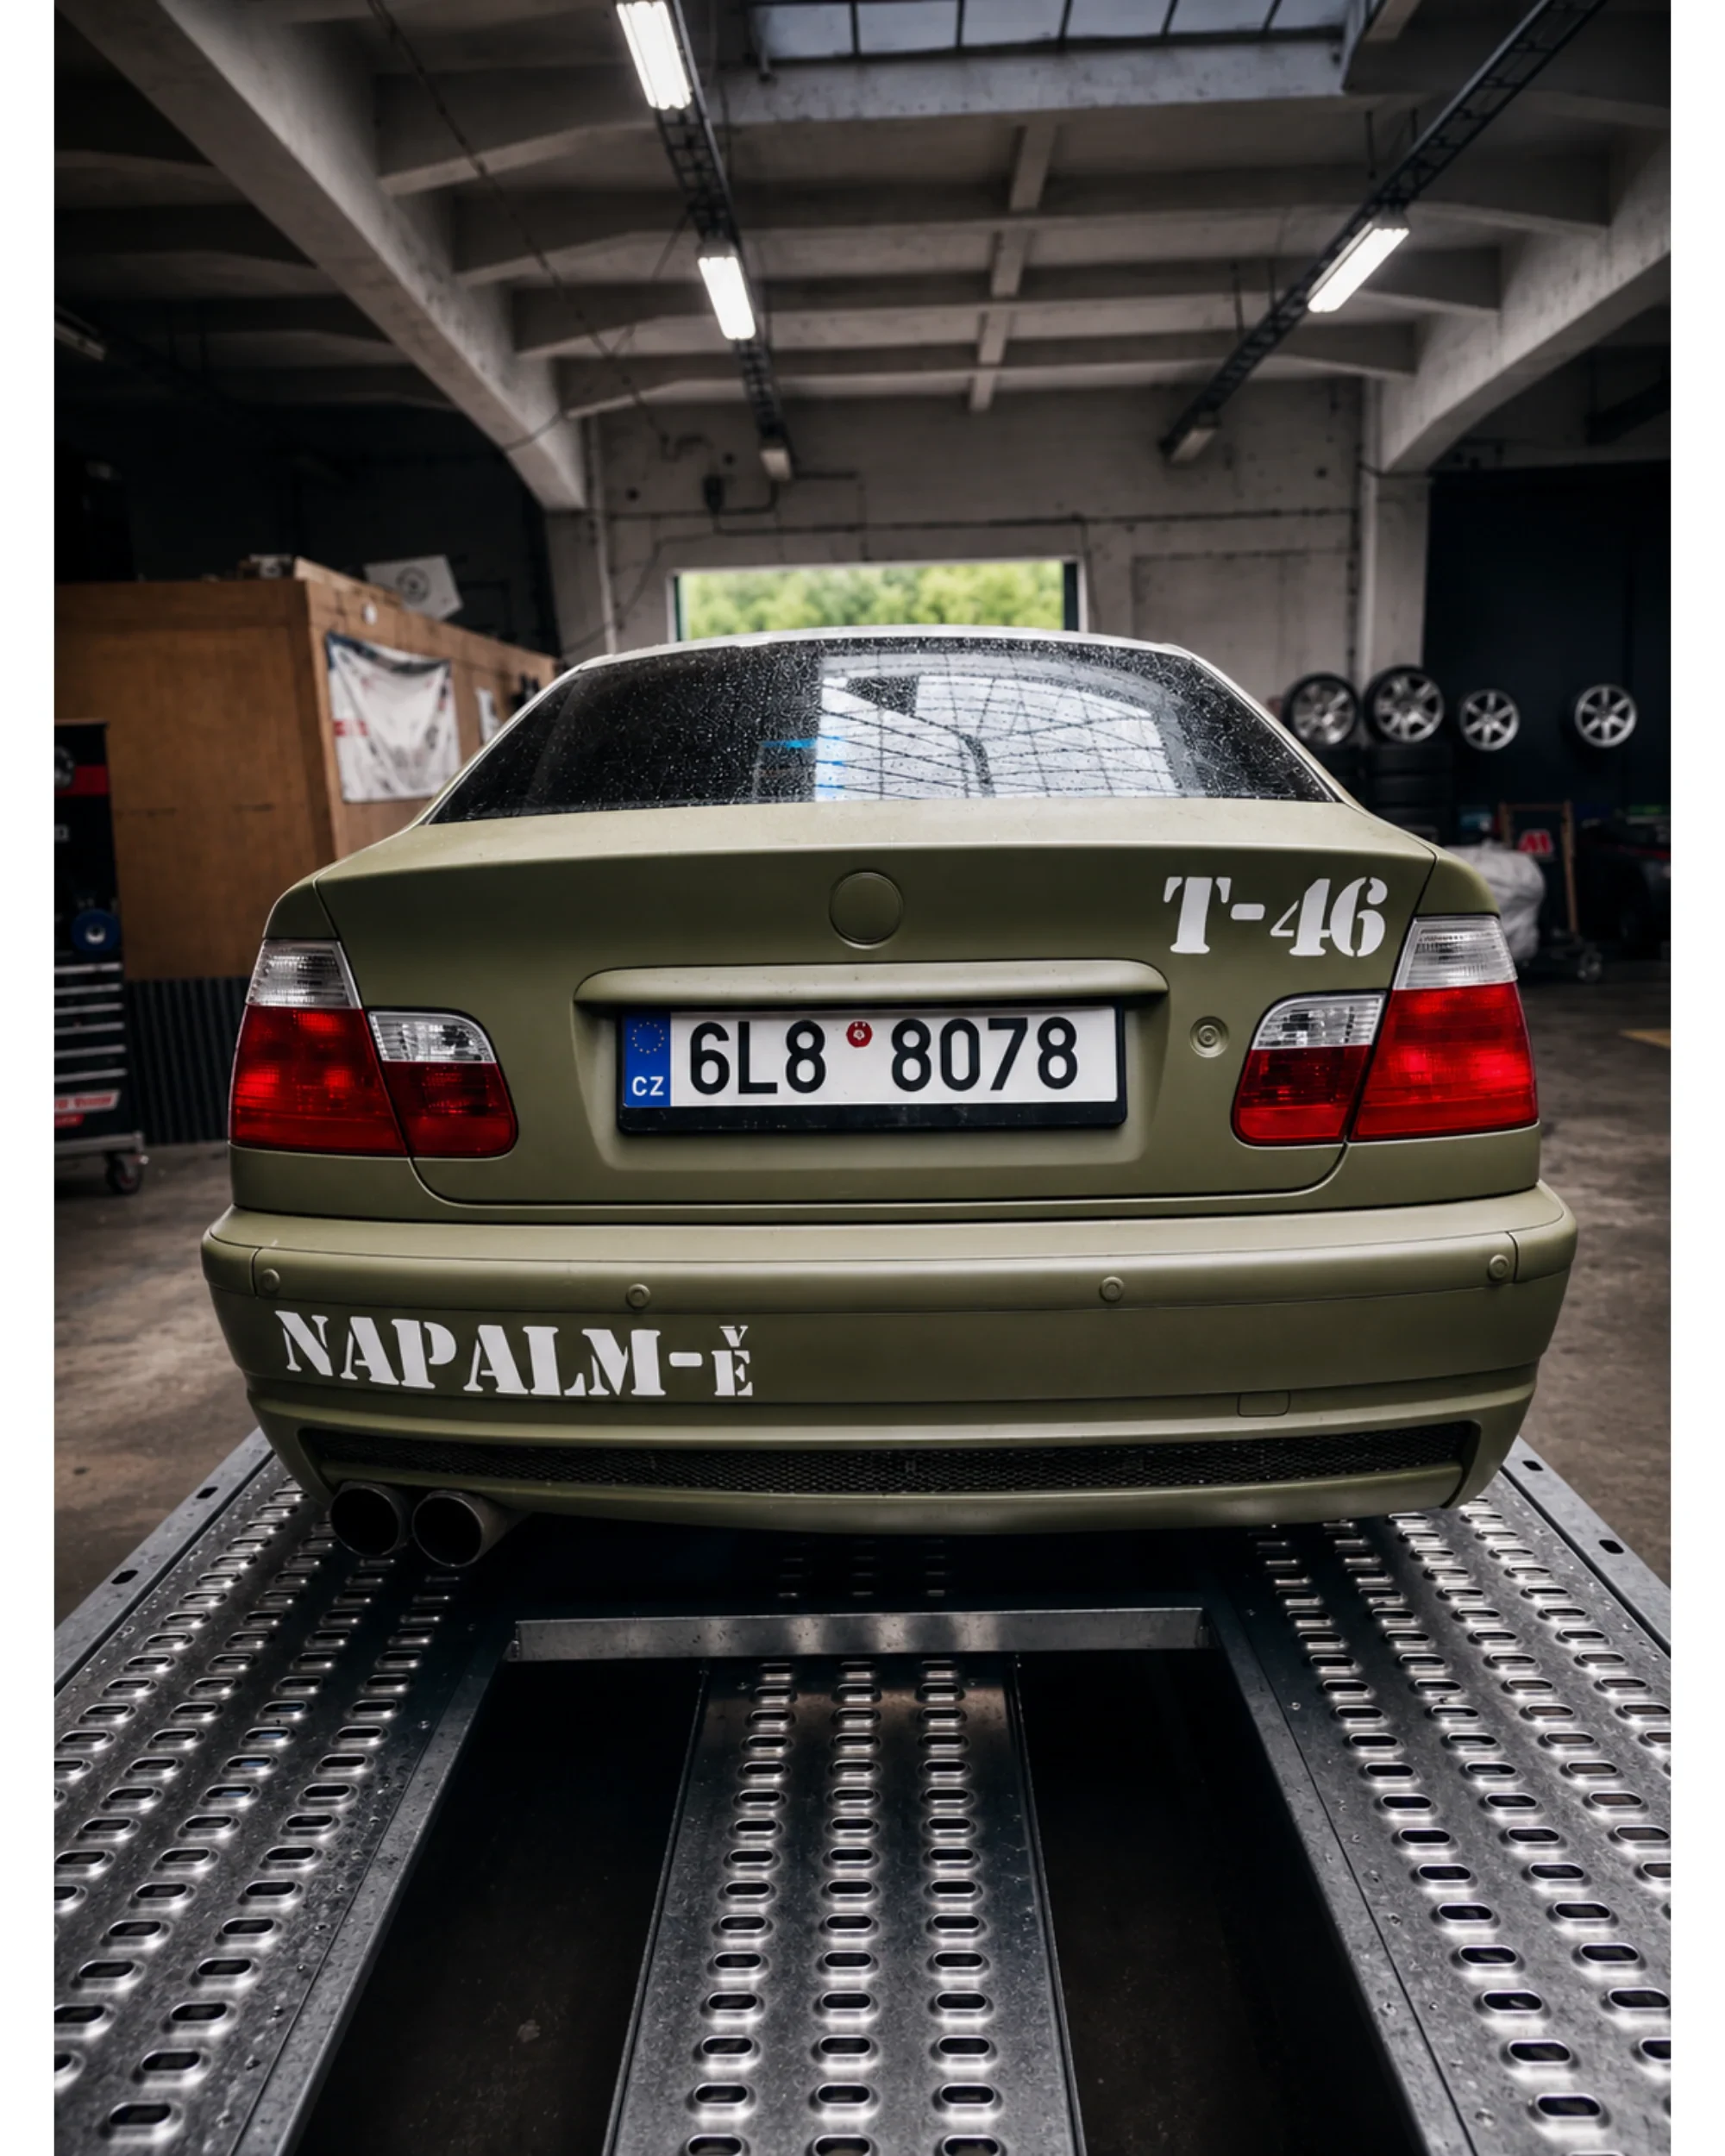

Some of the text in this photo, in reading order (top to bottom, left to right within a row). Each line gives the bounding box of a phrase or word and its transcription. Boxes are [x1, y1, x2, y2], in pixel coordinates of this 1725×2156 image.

[1163, 876, 1388, 957] T-46
[631, 1075, 664, 1097] CZ
[689, 1017, 1078, 1094] 6L8 8078
[274, 1310, 753, 1396] NAPALM-Ě
